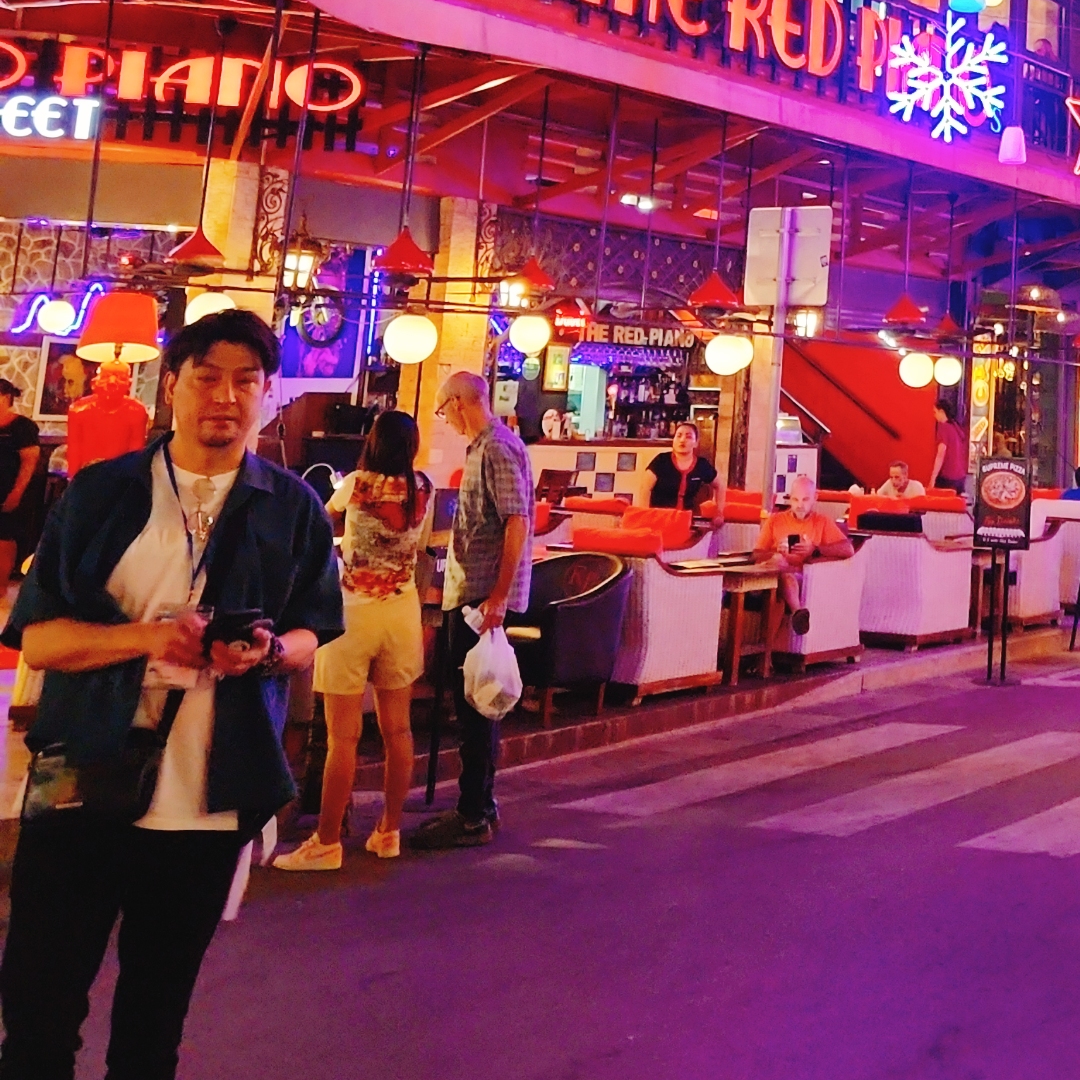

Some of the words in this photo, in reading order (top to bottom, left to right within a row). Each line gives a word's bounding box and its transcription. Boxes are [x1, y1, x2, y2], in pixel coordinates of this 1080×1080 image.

[53, 45, 362, 113] PIANO
[982, 462, 1009, 473] SUPREME
[1009, 463, 1026, 476] PIZZA
